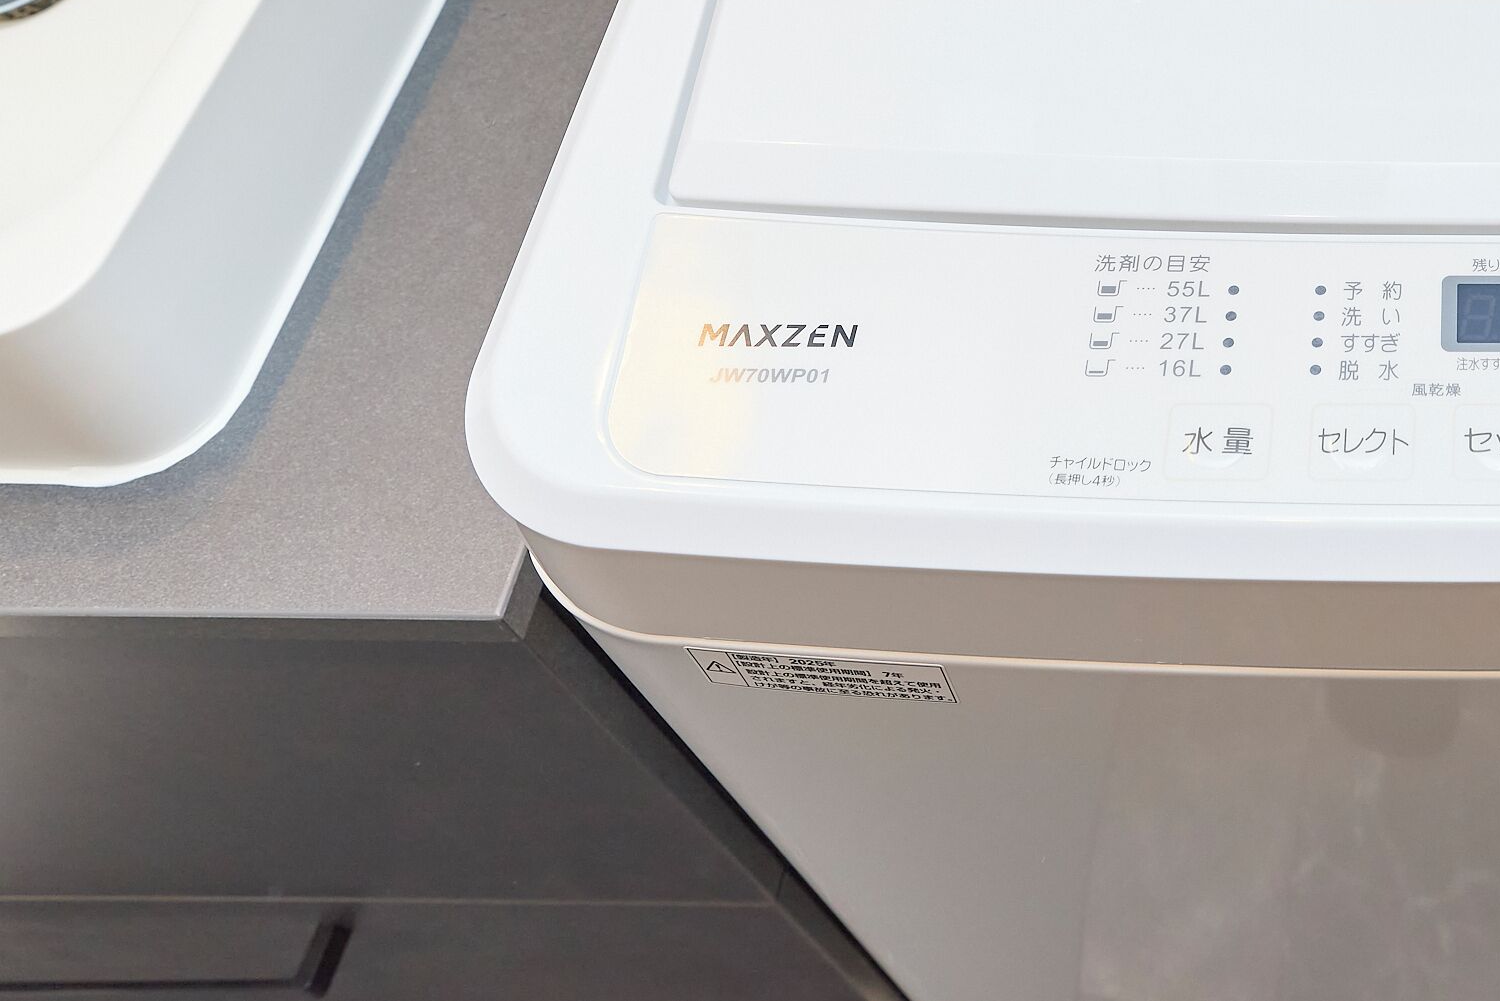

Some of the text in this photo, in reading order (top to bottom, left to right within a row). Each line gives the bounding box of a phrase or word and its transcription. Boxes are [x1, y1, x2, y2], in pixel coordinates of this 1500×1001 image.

[1094, 254, 1211, 273] 洗剤の目安
[1166, 280, 1210, 297] 55L
[1343, 281, 1402, 301] 予約
[1164, 306, 1208, 323] 37L
[1341, 306, 1400, 327] 洗い
[698, 323, 859, 348] MAXZEN
[1159, 333, 1204, 350] 27L
[1340, 333, 1400, 353] すすぎ
[710, 368, 830, 383] JW70WP01
[1159, 359, 1202, 377] 16L
[1338, 360, 1399, 381] 脱水
[1411, 382, 1462, 397] 風乾燥
[1182, 426, 1254, 455] 水量
[1318, 427, 1409, 455] セレクト
[1049, 455, 1152, 473] チャイルドロック
[1048, 473, 1121, 488] (長押し4秒)
